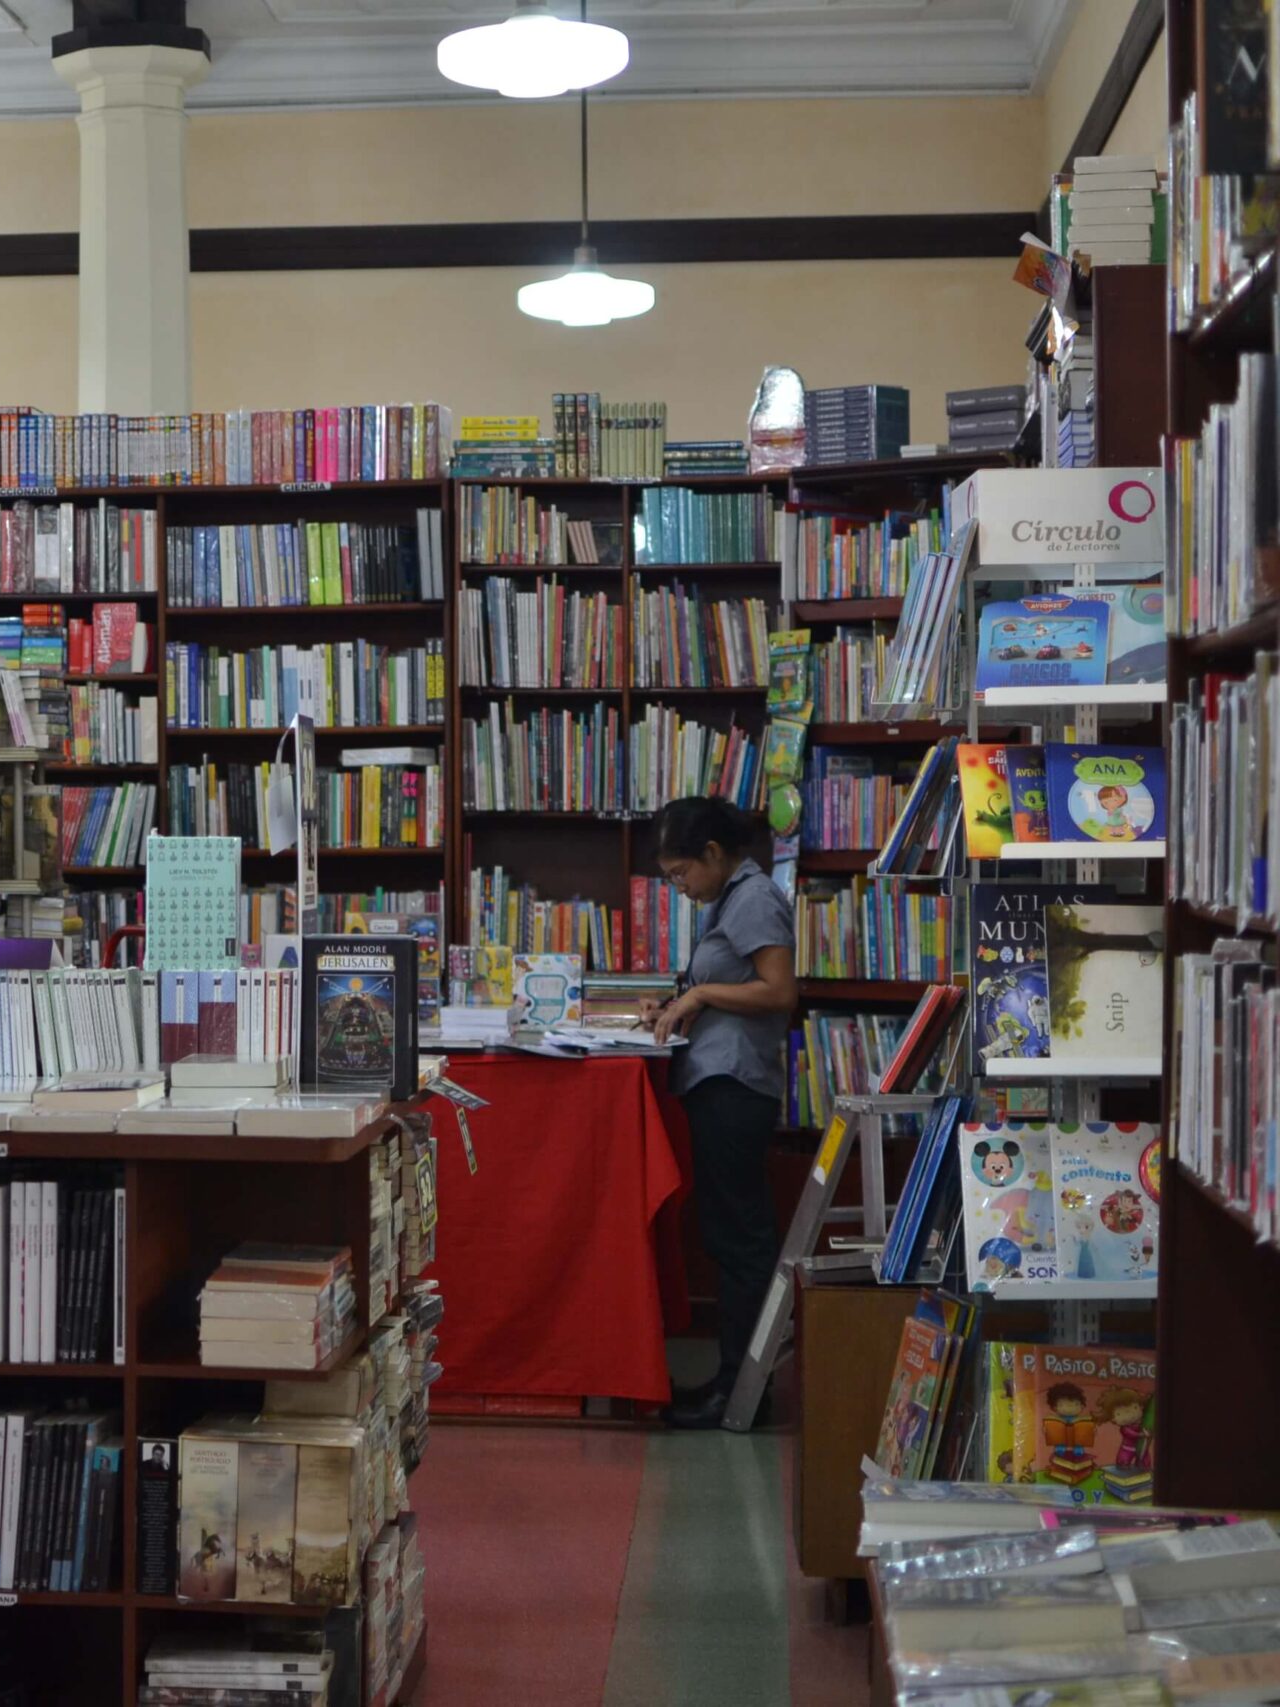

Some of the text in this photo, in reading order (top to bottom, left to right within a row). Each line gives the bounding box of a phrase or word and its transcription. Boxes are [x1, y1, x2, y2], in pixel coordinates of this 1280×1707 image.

[283, 482, 326, 492] CIENCIA
[1012, 520, 1121, 542] Círculo
[1047, 542, 1121, 551] de Lectores
[1030, 602, 1062, 610] AVIONES
[97, 608, 112, 664] Alemán
[1010, 663, 1072, 679] AMIGOS
[1093, 764, 1127, 776] ANA
[995, 894, 1085, 911] ATLAS
[324, 945, 387, 954] ALAN MOORE
[1106, 992, 1129, 1032] Snip
[1061, 1166, 1132, 1183] contento
